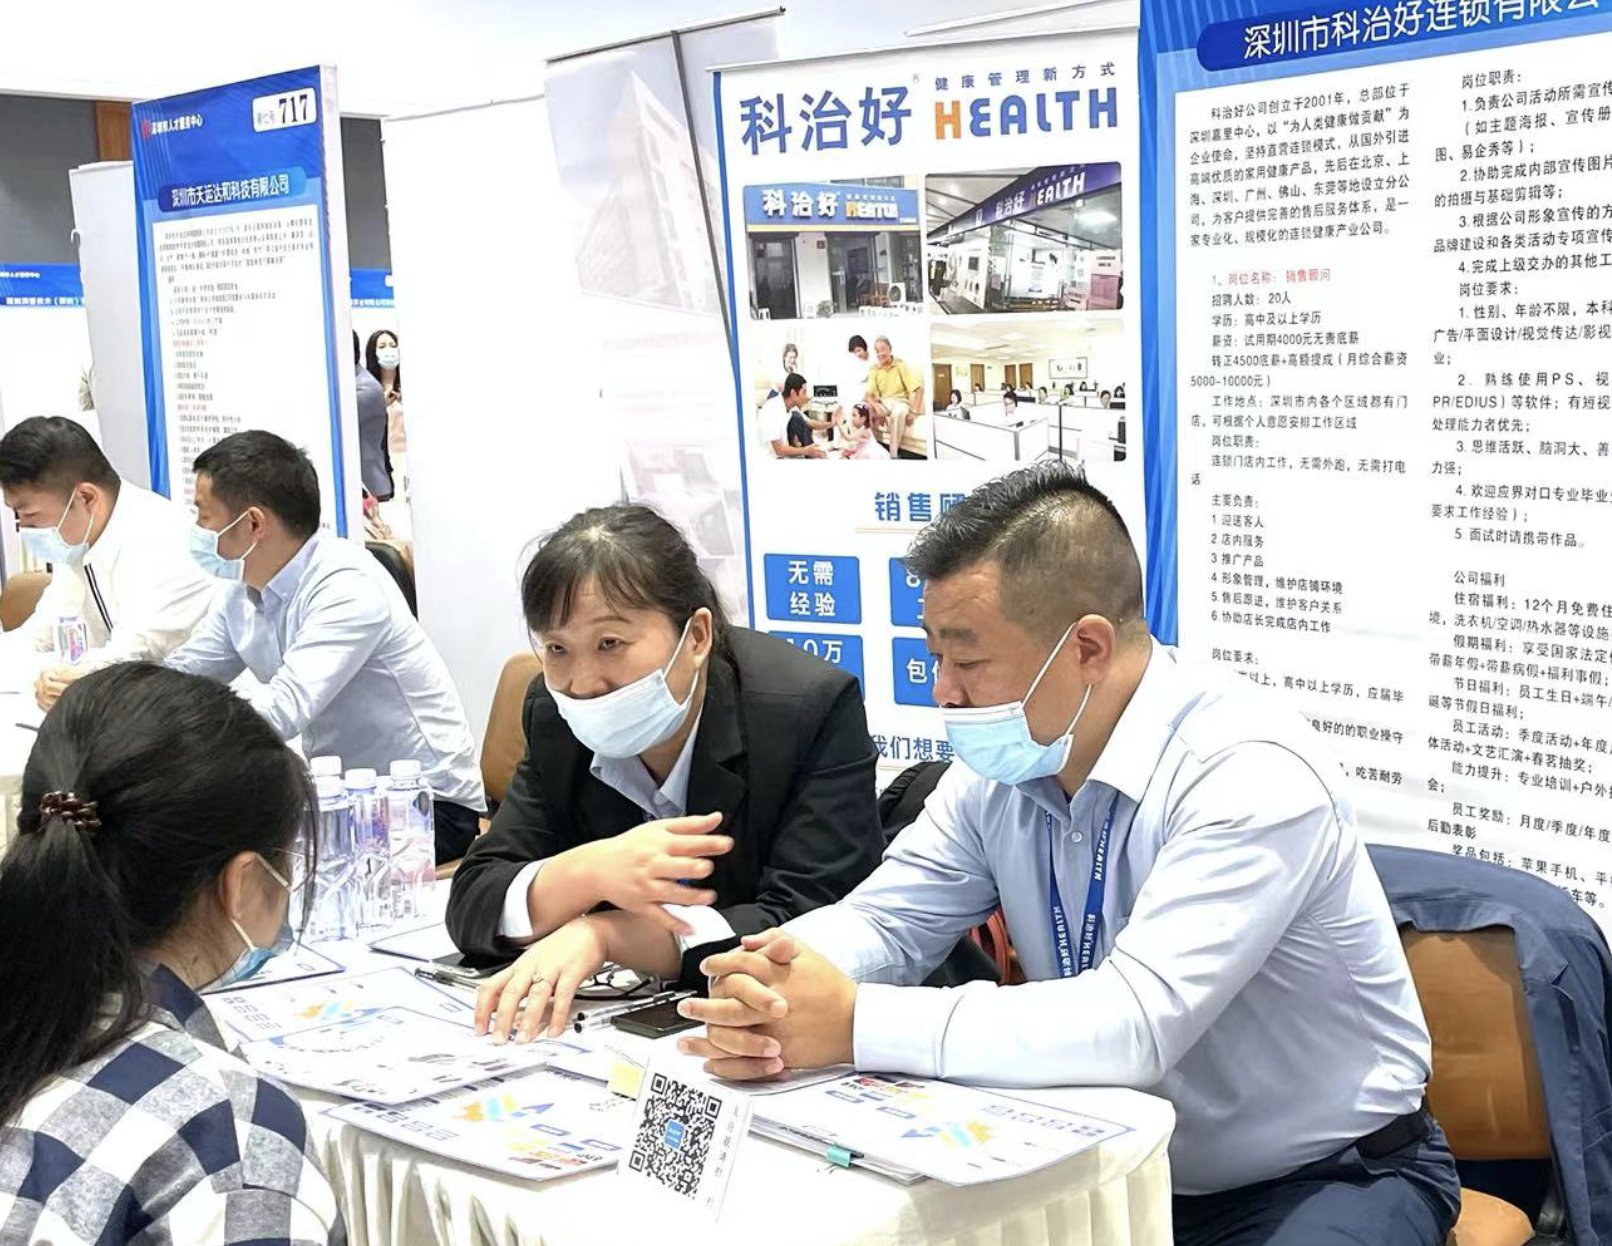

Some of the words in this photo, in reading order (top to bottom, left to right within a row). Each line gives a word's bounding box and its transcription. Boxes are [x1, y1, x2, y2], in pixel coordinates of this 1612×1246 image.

[935, 61, 1116, 91] 健康管理新方式
[1461, 69, 1522, 89] 岗位职责：
[278, 93, 308, 124] 717
[740, 85, 912, 156] 科治好
[934, 87, 1118, 140] HEALTH
[1459, 281, 1519, 297] 岗位要求：
[1211, 434, 1260, 449] 岗位职责：
[1191, 473, 1201, 485] 话
[1455, 483, 1612, 504] 4.欢迎应界对口专业毕业
[788, 560, 834, 586] 无需
[1453, 570, 1506, 588] 公司福利
[789, 592, 836, 618] 经验
[1211, 647, 1259, 665] 岗位要求：
[1453, 634, 1612, 664] 假期福利：享受国家法定
[1237, 670, 1405, 703] 以上，高中以上学历，应届毕
[1453, 718, 1612, 755] 员工活动：季度活动+年度
[1452, 760, 1612, 799] 能力提升：专业培训+户外
[1427, 818, 1477, 840] 后勤表彰
[1452, 843, 1612, 887] 奖品包括：苹果手机、平
